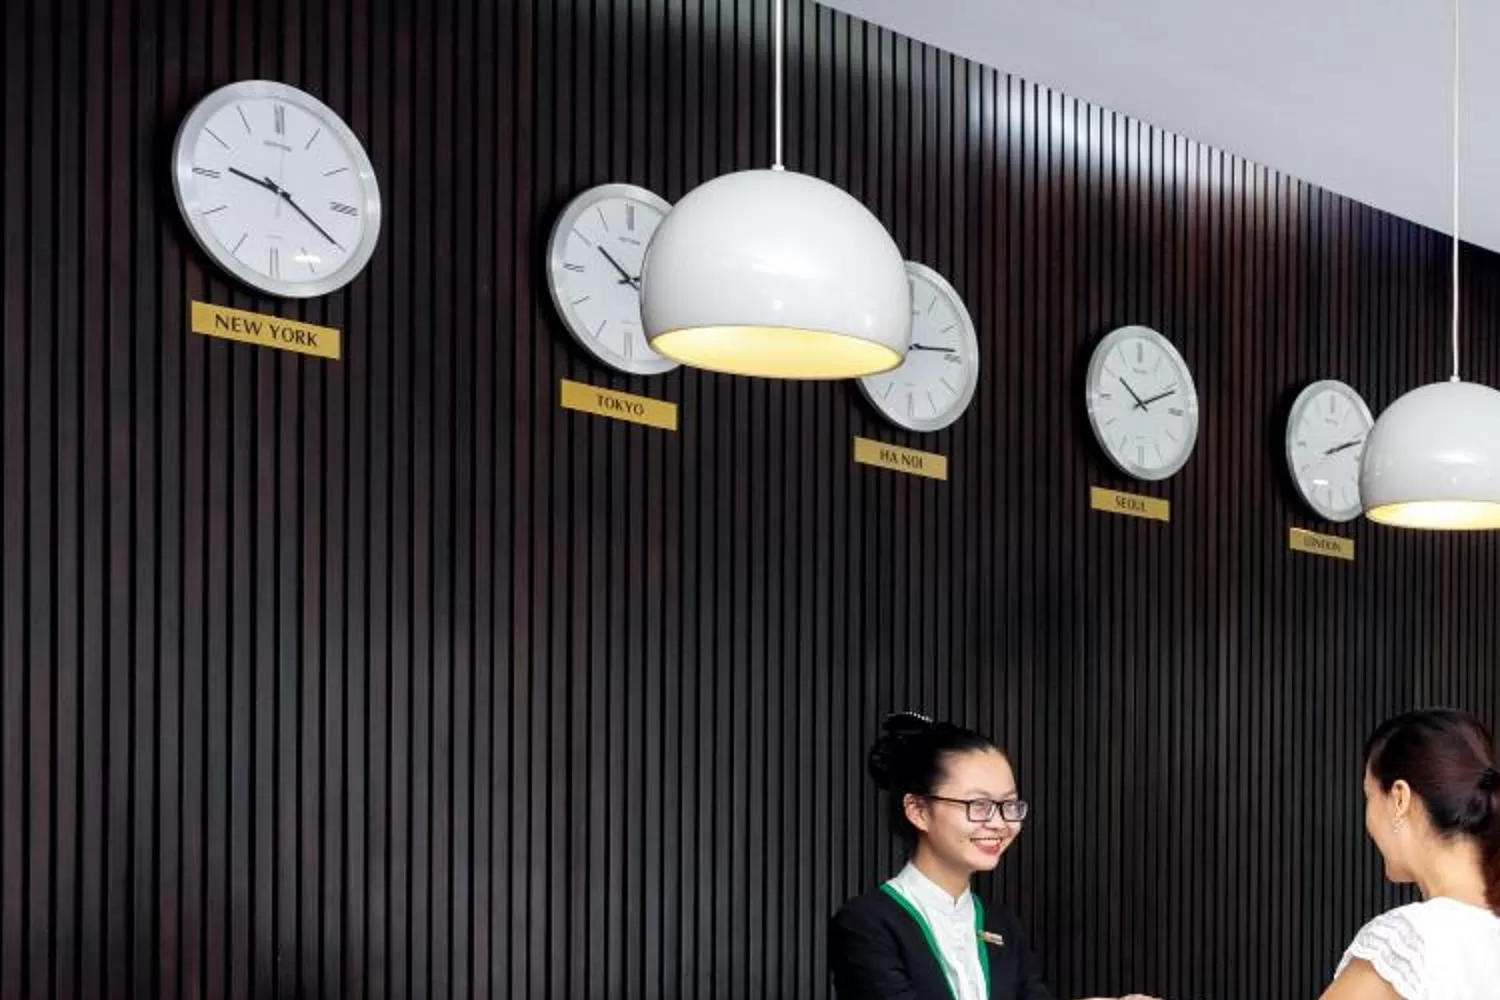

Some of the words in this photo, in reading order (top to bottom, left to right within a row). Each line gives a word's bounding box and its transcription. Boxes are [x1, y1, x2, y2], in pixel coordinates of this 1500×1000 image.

[214, 313, 263, 337] NEW
[269, 323, 318, 348] YORK
[597, 395, 645, 417] TOKYO
[1115, 495, 1149, 513] SEOUL
